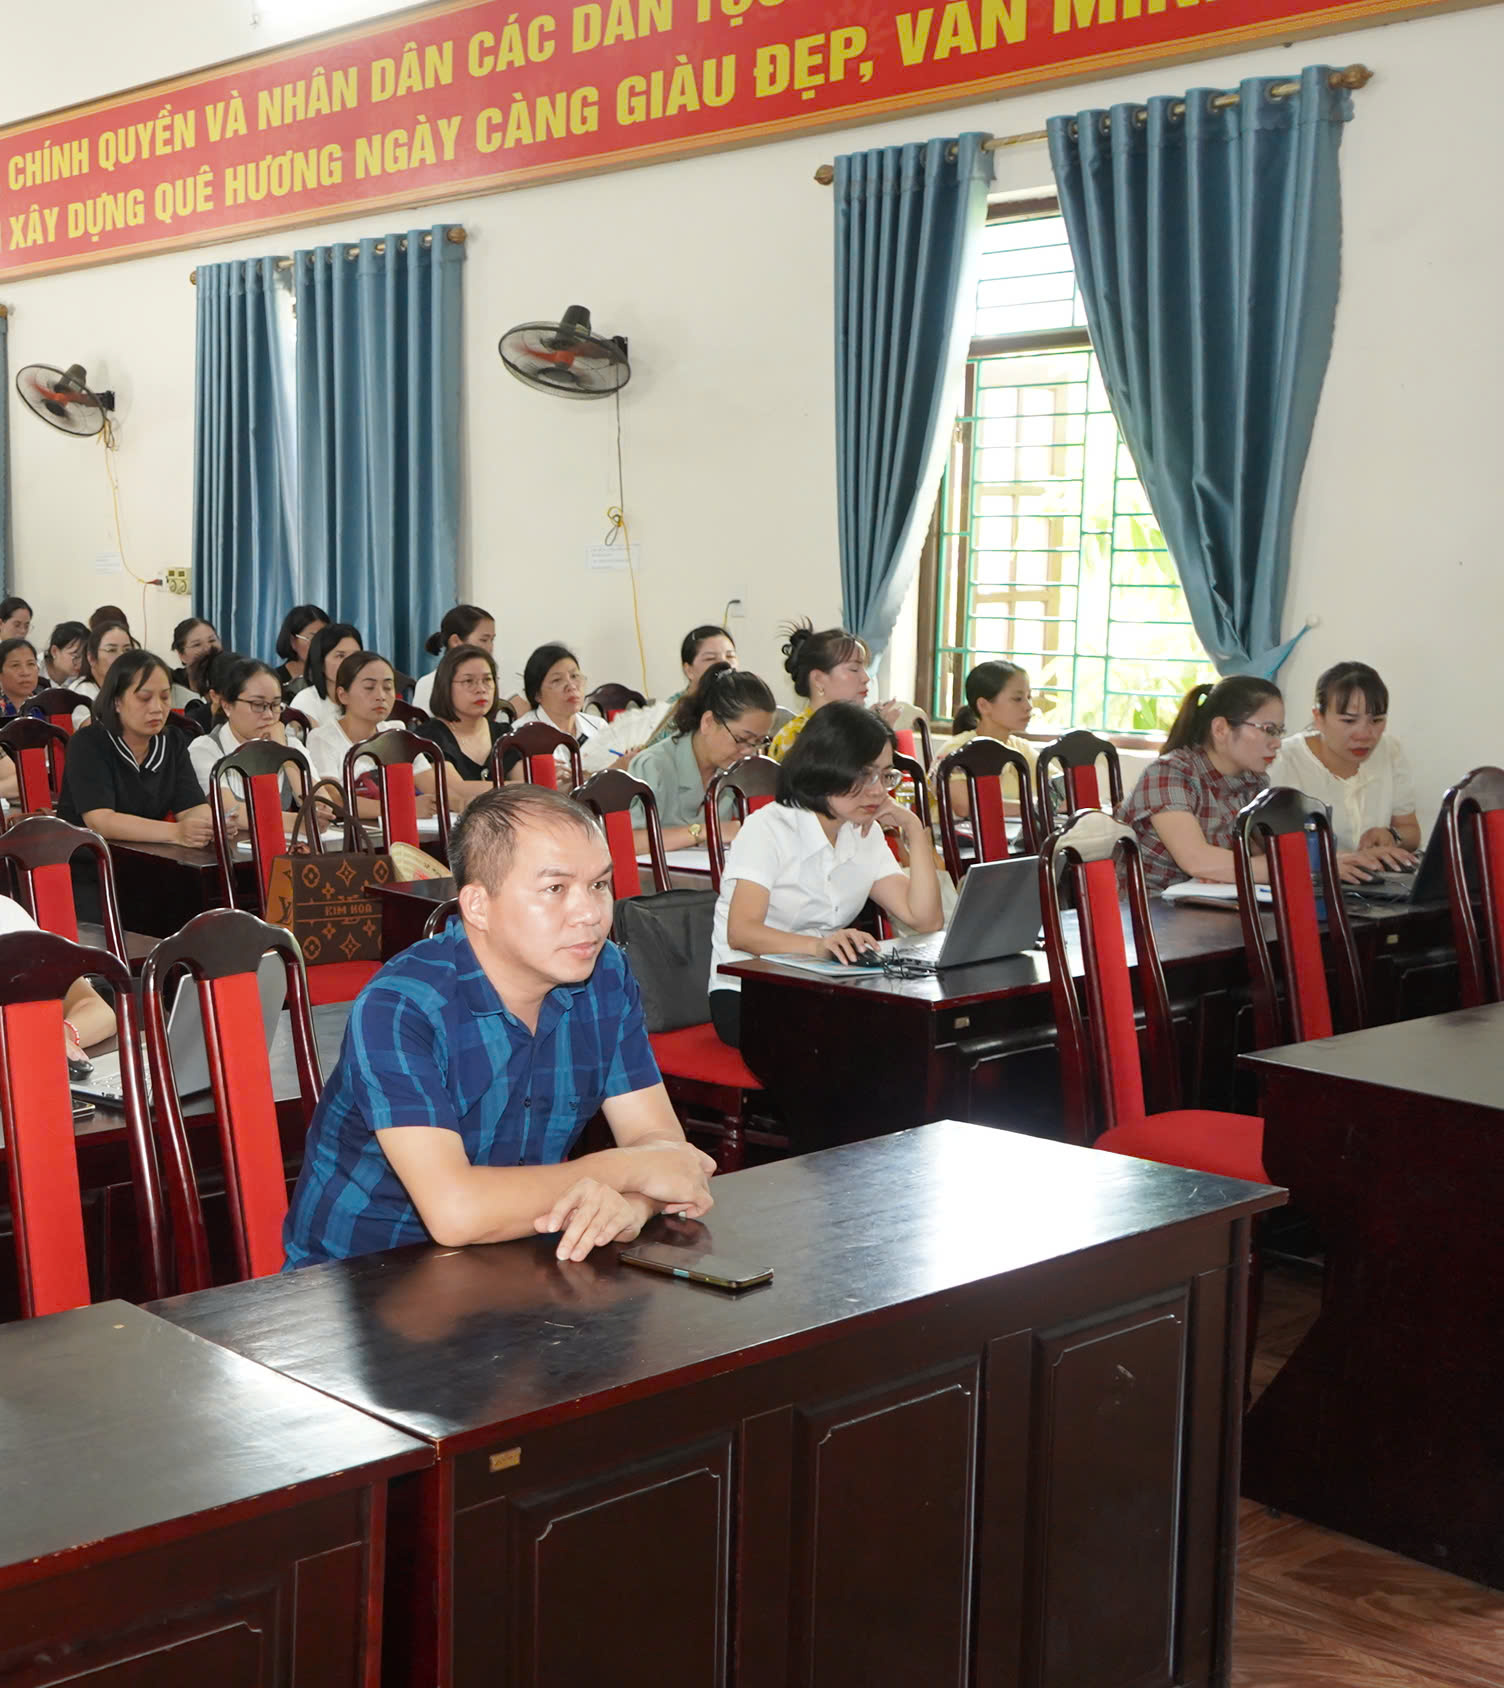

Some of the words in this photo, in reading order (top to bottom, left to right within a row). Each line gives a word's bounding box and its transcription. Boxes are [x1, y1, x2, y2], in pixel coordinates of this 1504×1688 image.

[8, 140, 90, 191] CHÍNH
[98, 104, 196, 172] QUYỀN
[205, 90, 248, 143] VÀ
[258, 66, 358, 130] NHÂN
[371, 41, 453, 103] DÂN
[468, 13, 556, 77] CÁC
[9, 204, 60, 250] XÂY
[67, 188, 145, 242] DỰNG
[154, 165, 214, 224] QUÊ
[224, 143, 343, 206] HƯƠNG
[355, 114, 463, 180] NGÀY
[475, 86, 600, 154] CÀNG
[616, 54, 737, 126] GIÀU
[753, 26, 874, 101] ĐẸP,
